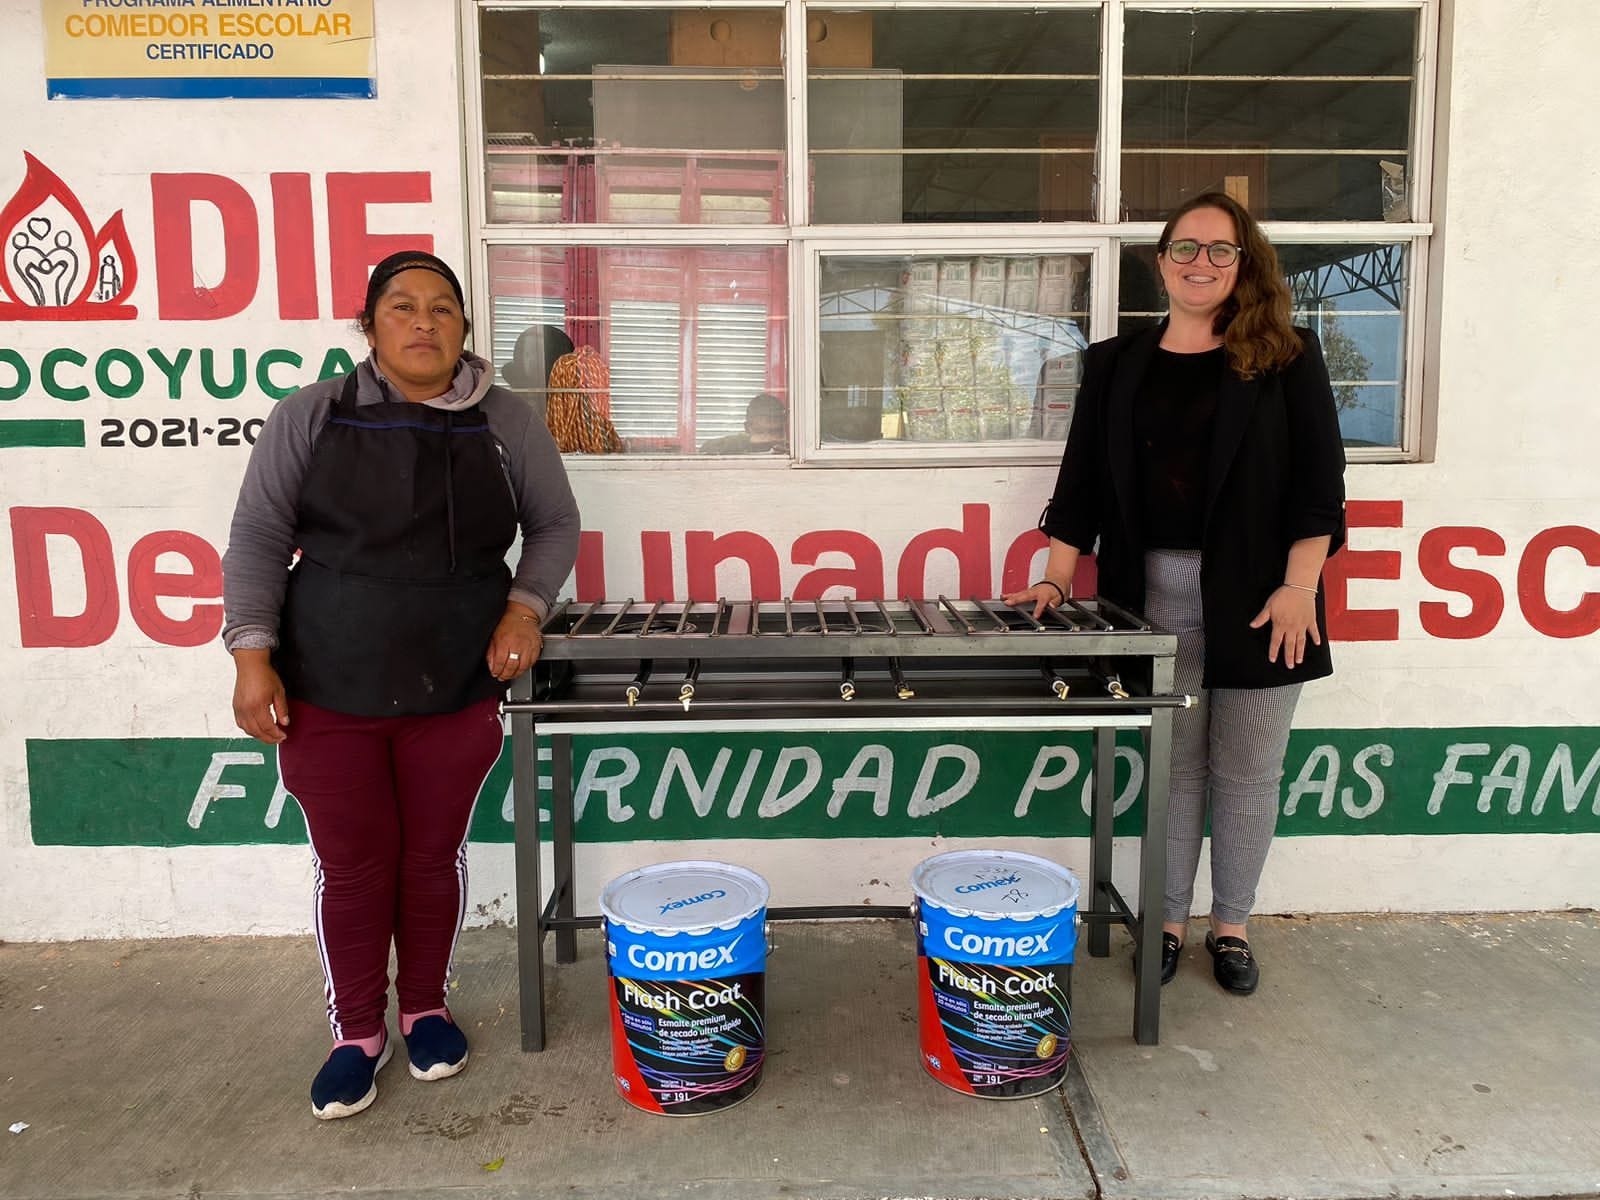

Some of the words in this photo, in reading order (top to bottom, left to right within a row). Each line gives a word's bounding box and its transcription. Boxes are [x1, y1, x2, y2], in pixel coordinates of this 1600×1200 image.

[65, 13, 208, 38] COMEDOR
[219, 12, 351, 37] ESCOLAR
[146, 43, 273, 60] CERTIFICADO
[150, 171, 435, 320] DIF
[0, 348, 356, 401] OCOYUCA
[1283, 743, 1394, 819] AS
[955, 871, 1019, 894] Comex
[658, 889, 726, 915] Comex
[628, 933, 744, 972] Comex
[944, 923, 1059, 957] Comex
[938, 965, 996, 995] Flash
[1004, 972, 1055, 995] Coat
[624, 984, 680, 1010] Flash
[688, 982, 742, 1009] Coat
[973, 1001, 1005, 1011] Esmalte
[1006, 1001, 1040, 1013] premium
[658, 1018, 690, 1027] Esmalte
[691, 1014, 726, 1028] premium
[973, 1011, 984, 1019] de
[985, 1012, 1013, 1021] secado
[1014, 1011, 1032, 1020] ultra
[670, 1029, 698, 1037] secado
[699, 1025, 719, 1035] ultra
